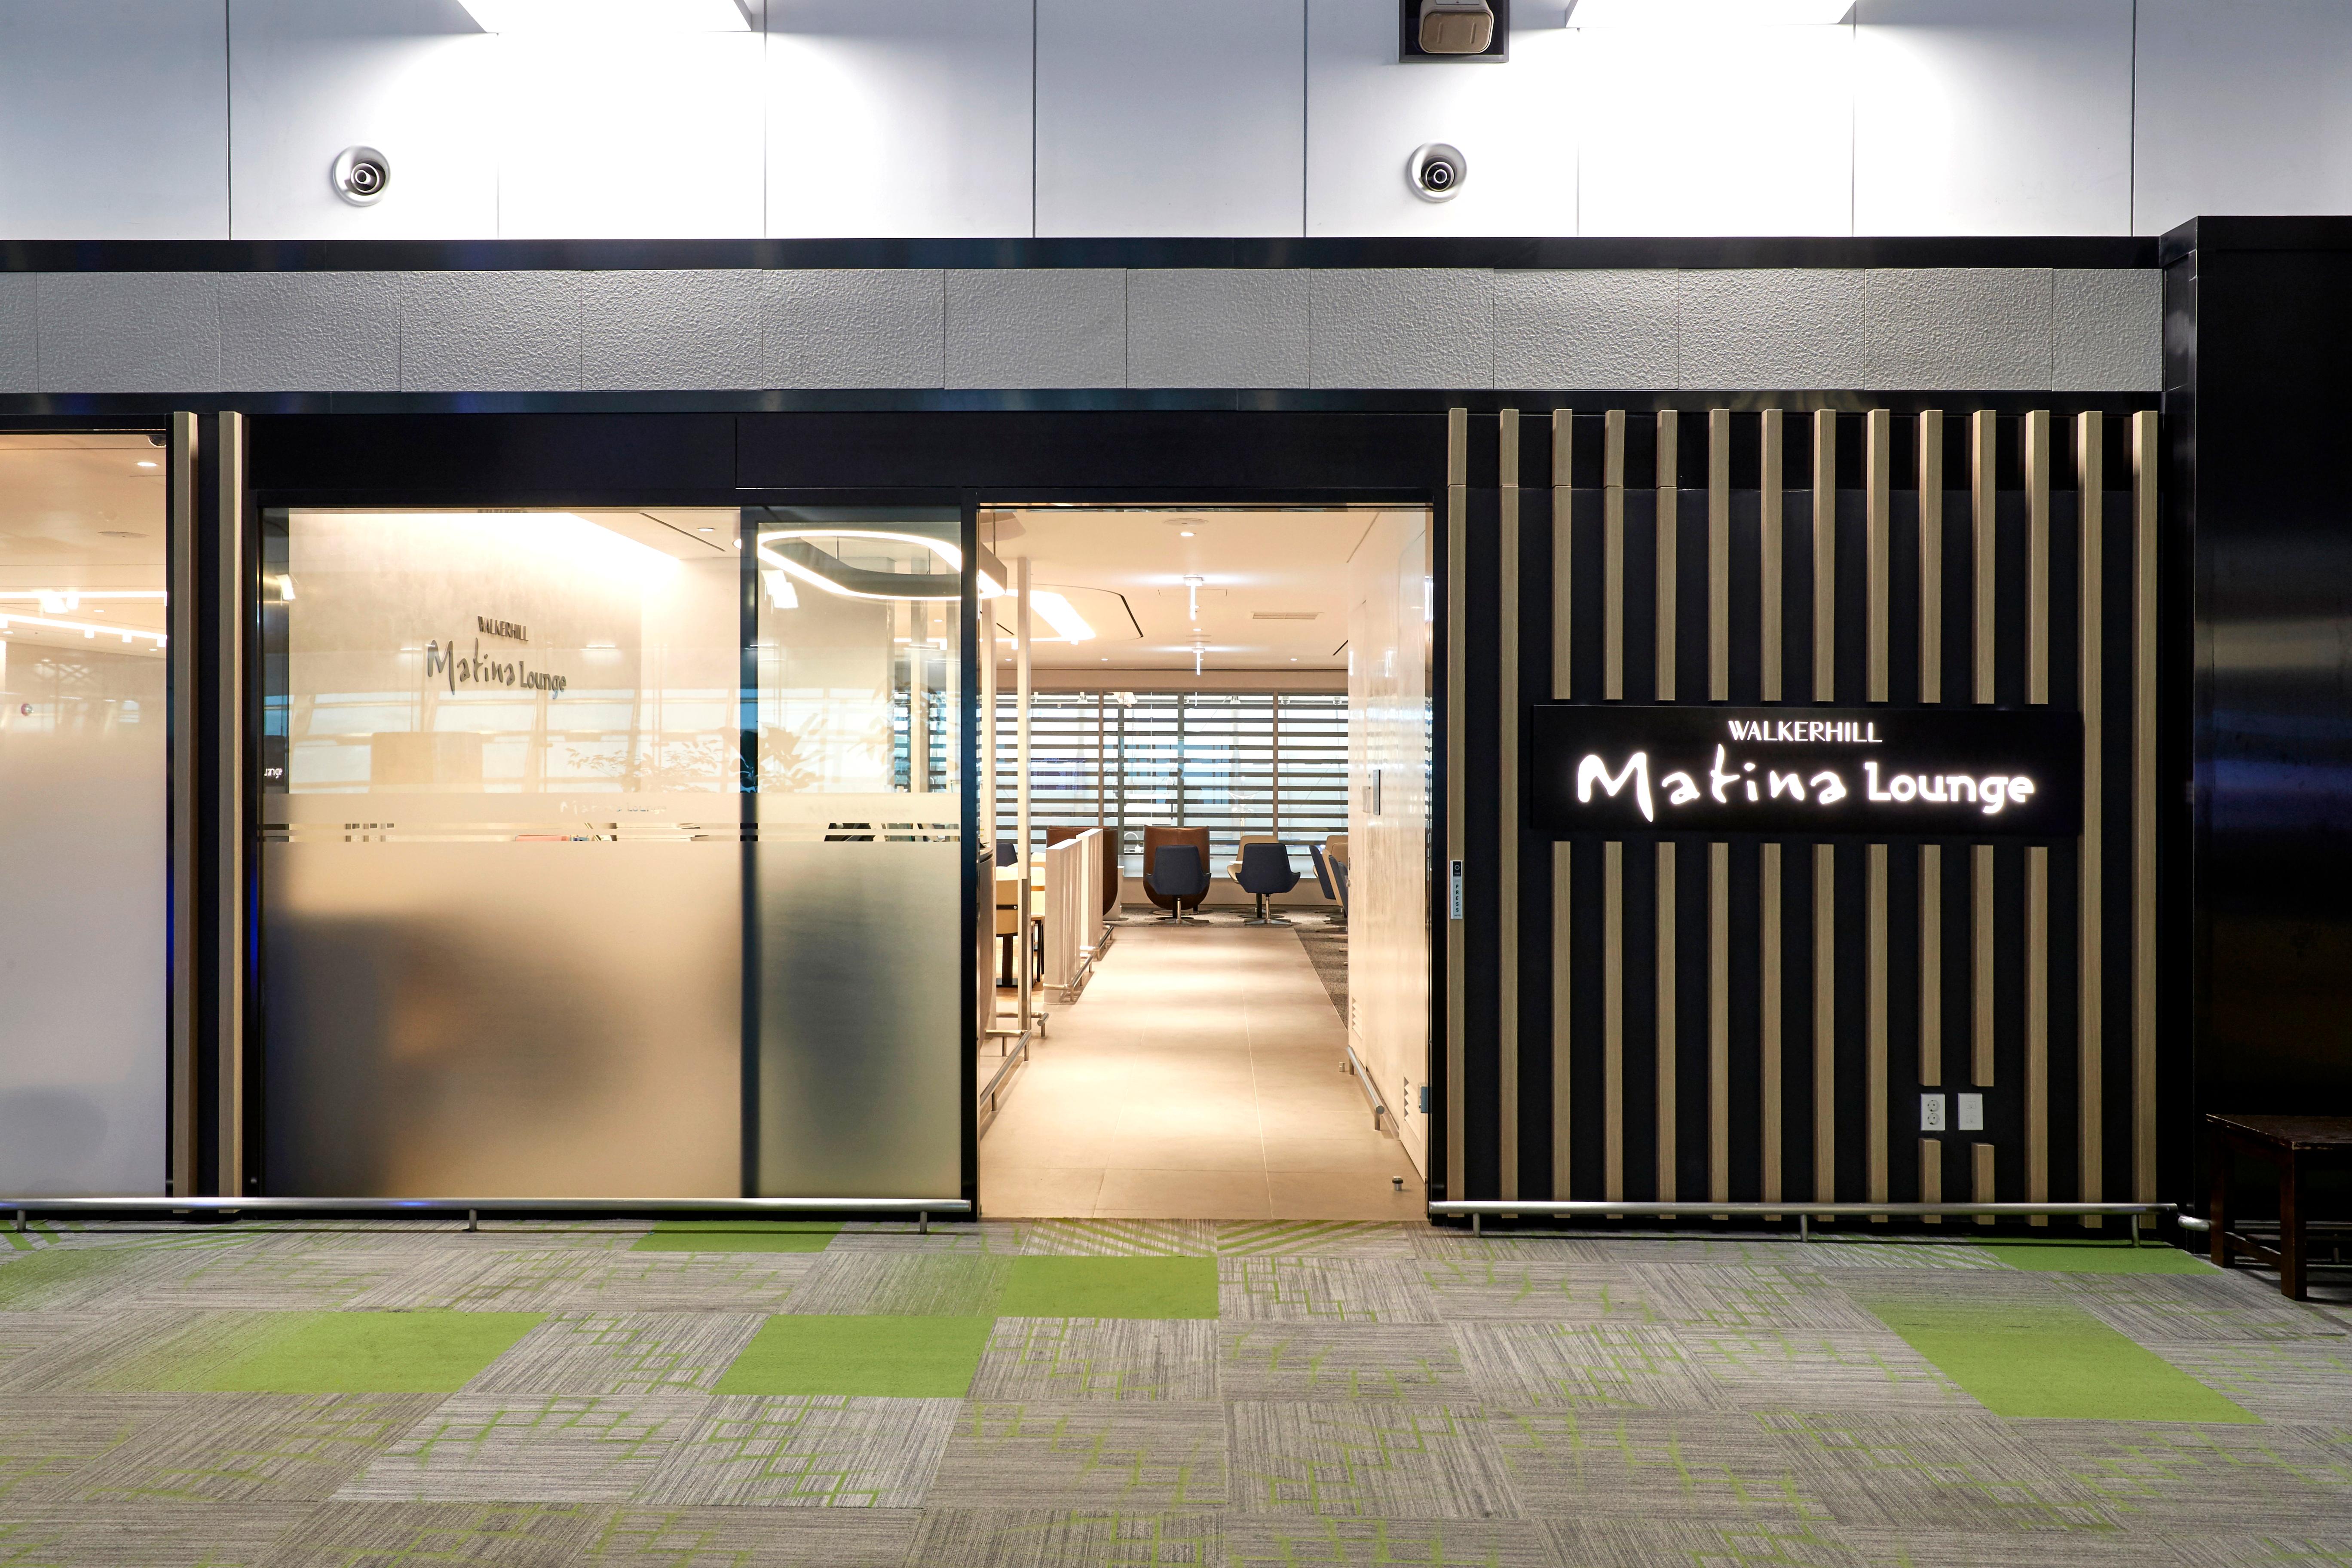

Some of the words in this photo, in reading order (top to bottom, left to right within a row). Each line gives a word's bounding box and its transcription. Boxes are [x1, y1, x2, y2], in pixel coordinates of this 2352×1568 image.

[478, 616, 529, 641] WALKERHILL
[427, 637, 516, 695] Matina
[519, 660, 567, 699] Lounge
[1728, 720, 1883, 742] WALKERHILL
[1577, 743, 1847, 822] Matina
[1864, 761, 2035, 815] Lounge
